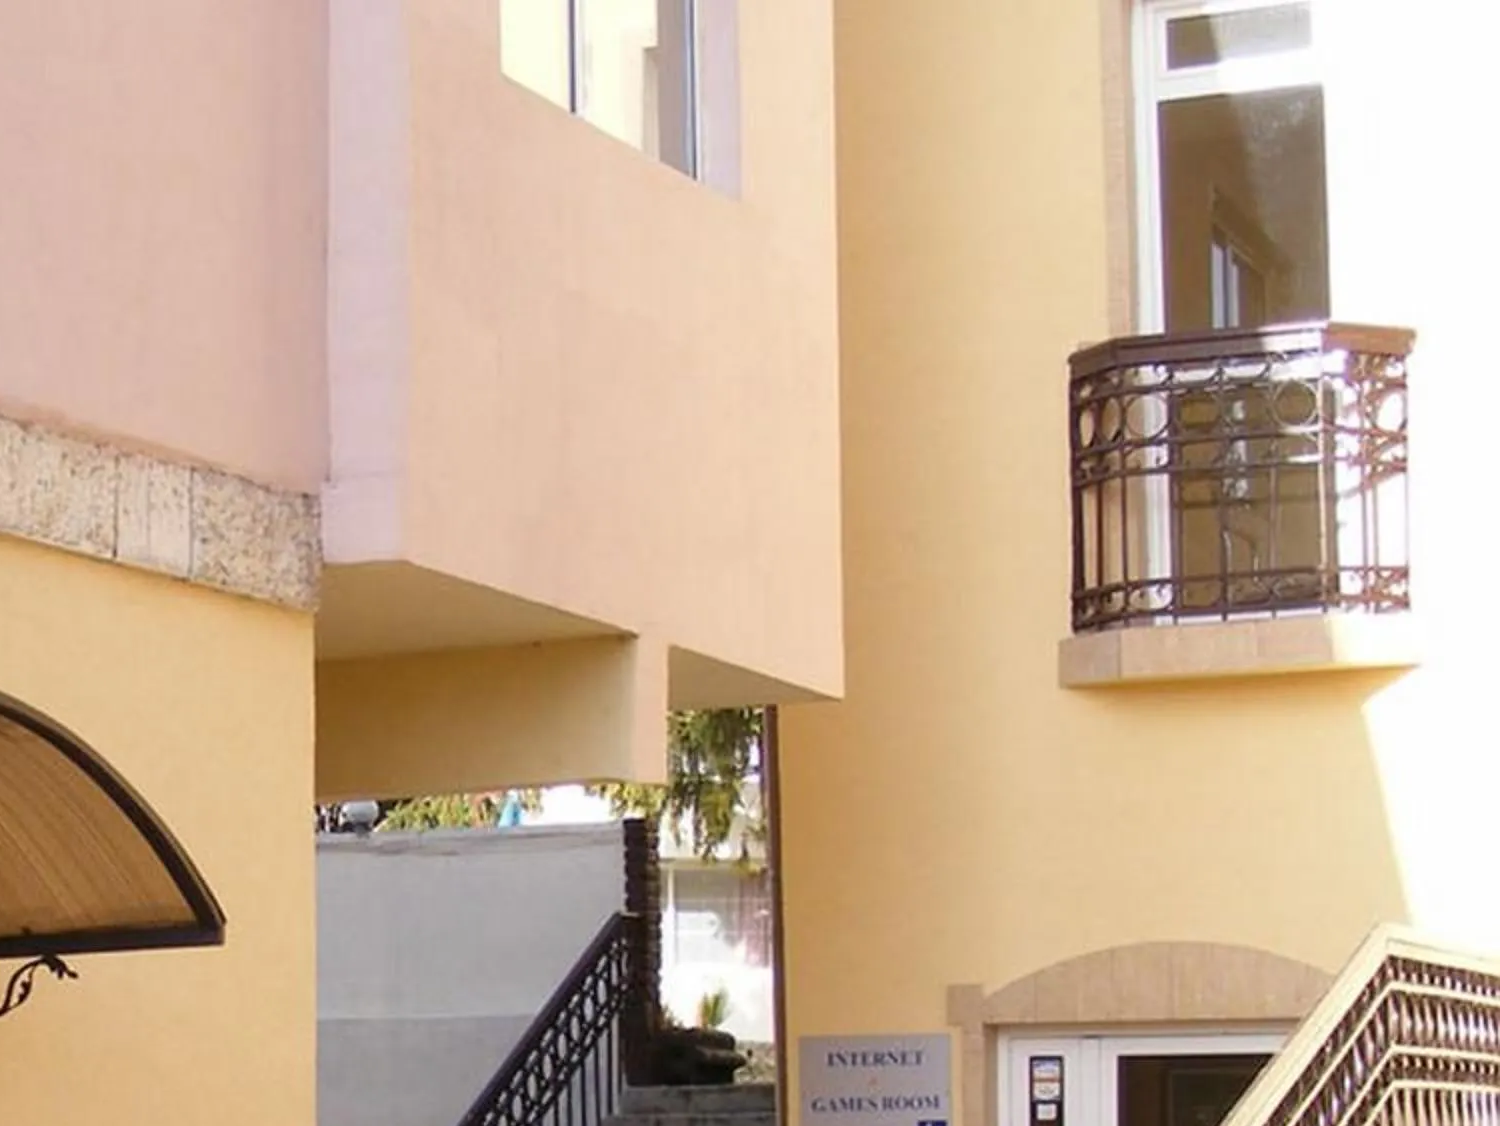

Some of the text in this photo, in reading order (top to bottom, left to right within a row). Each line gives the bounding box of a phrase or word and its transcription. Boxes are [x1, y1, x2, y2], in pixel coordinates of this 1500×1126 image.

[827, 1050, 924, 1067] INTERNET
[811, 1096, 940, 1114] GAMES ROOM
